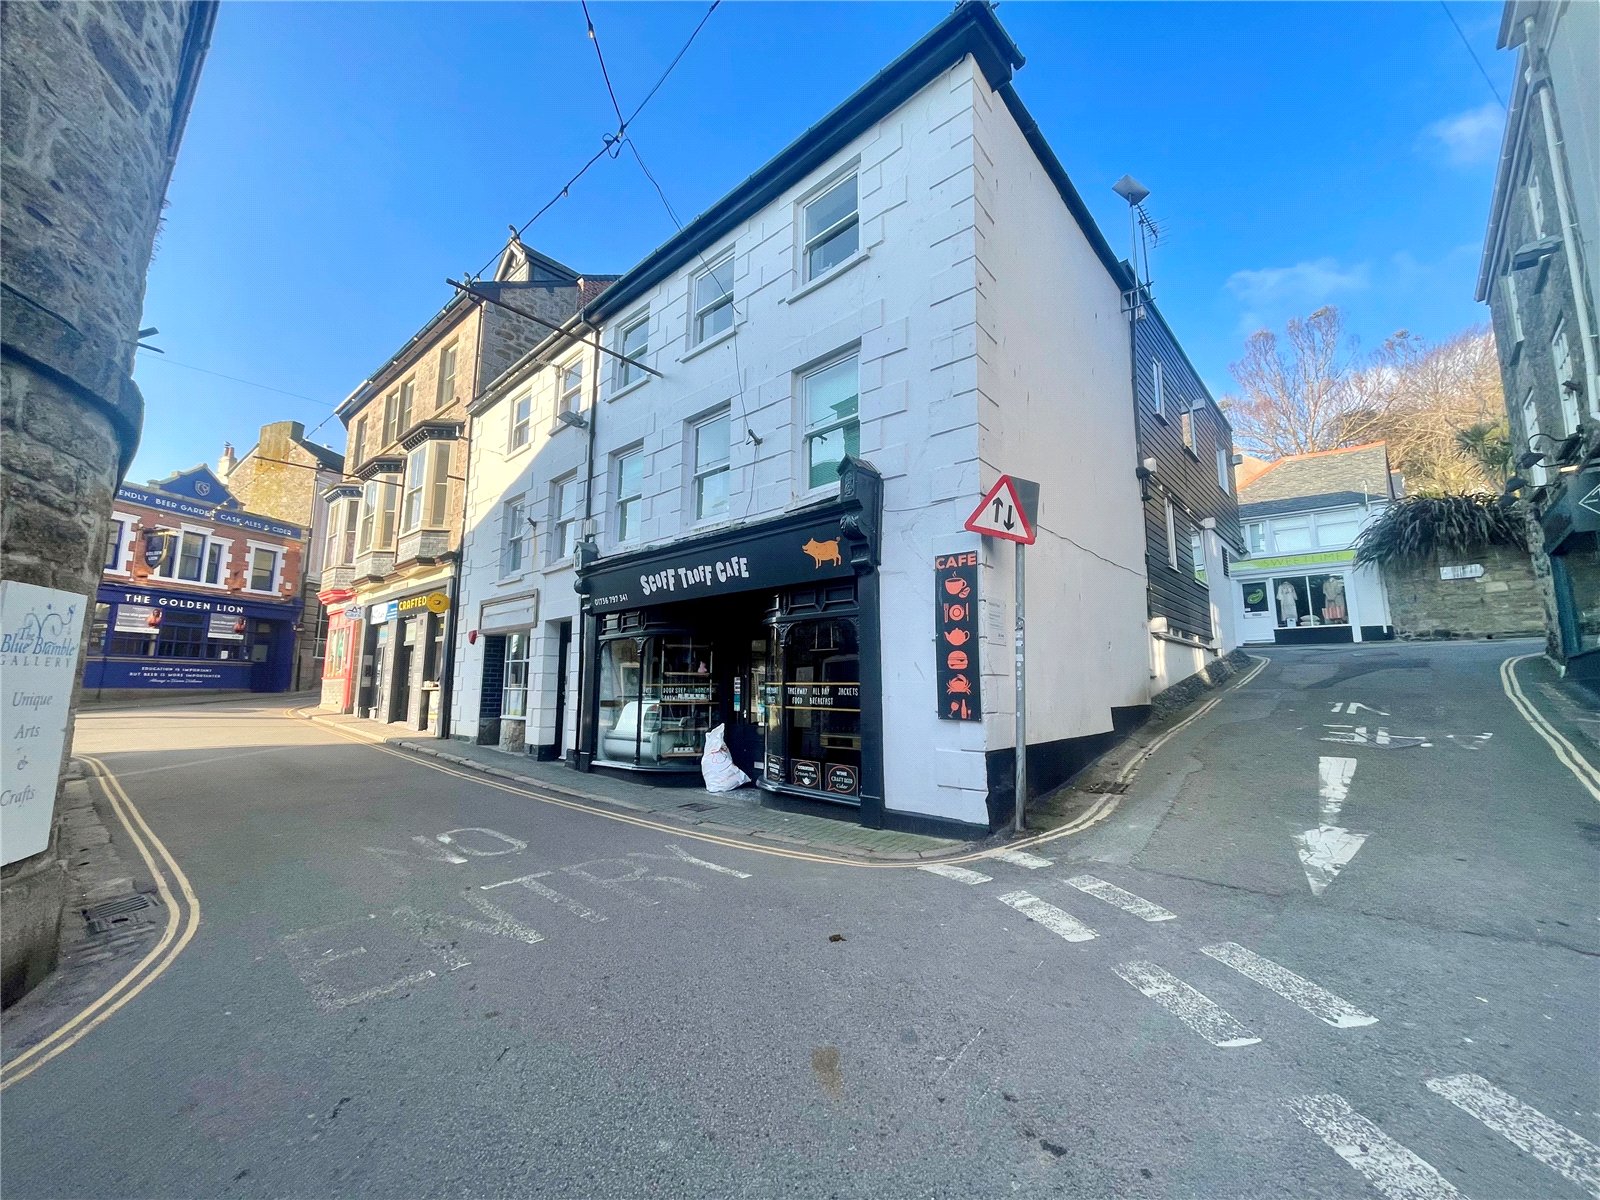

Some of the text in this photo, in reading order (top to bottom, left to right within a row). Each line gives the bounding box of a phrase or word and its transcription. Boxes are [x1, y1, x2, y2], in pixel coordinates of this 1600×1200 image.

[119, 489, 149, 502] ENDLY
[156, 498, 177, 508] BEER
[180, 504, 215, 517] GARDEN
[220, 514, 241, 523] CASK
[244, 519, 262, 529] ALES
[272, 526, 292, 536] CIDER
[936, 553, 977, 570] CAFE
[640, 556, 750, 596] SCOFF TROFF CAFE
[125, 594, 244, 614] THE GOLDEN LION
[398, 596, 427, 611] CRAFTED
[594, 595, 609, 606] 01736
[0, 633, 75, 656] Blue Bramble
[812, 687, 830, 695] ALL DAY
[838, 687, 859, 696] JACKETS
[12, 692, 53, 711] Unique
[792, 697, 803, 705] FOOD
[809, 697, 834, 705] BREAKFAST
[14, 724, 41, 739] Arts
[17, 755, 29, 771] &
[0, 785, 36, 808] Crafts
